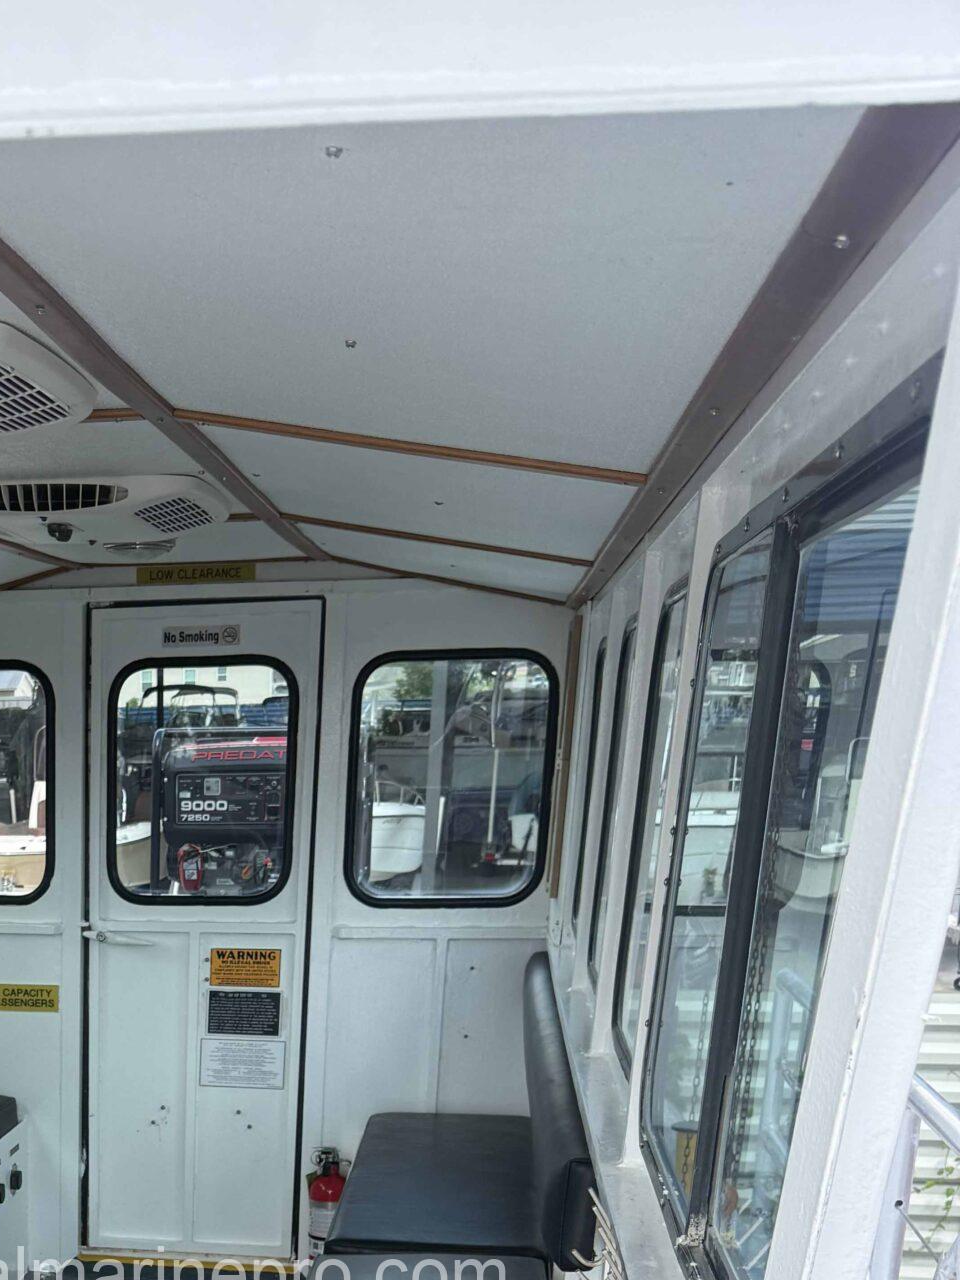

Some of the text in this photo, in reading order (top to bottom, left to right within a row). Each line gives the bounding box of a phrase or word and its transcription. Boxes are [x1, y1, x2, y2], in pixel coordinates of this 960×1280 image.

[149, 567, 242, 581] LOW CLEARANCE
[163, 629, 219, 644] No Smoking
[180, 800, 228, 811] 9000
[216, 950, 276, 960] WARNING
[2, 988, 53, 998] CAPACITY
